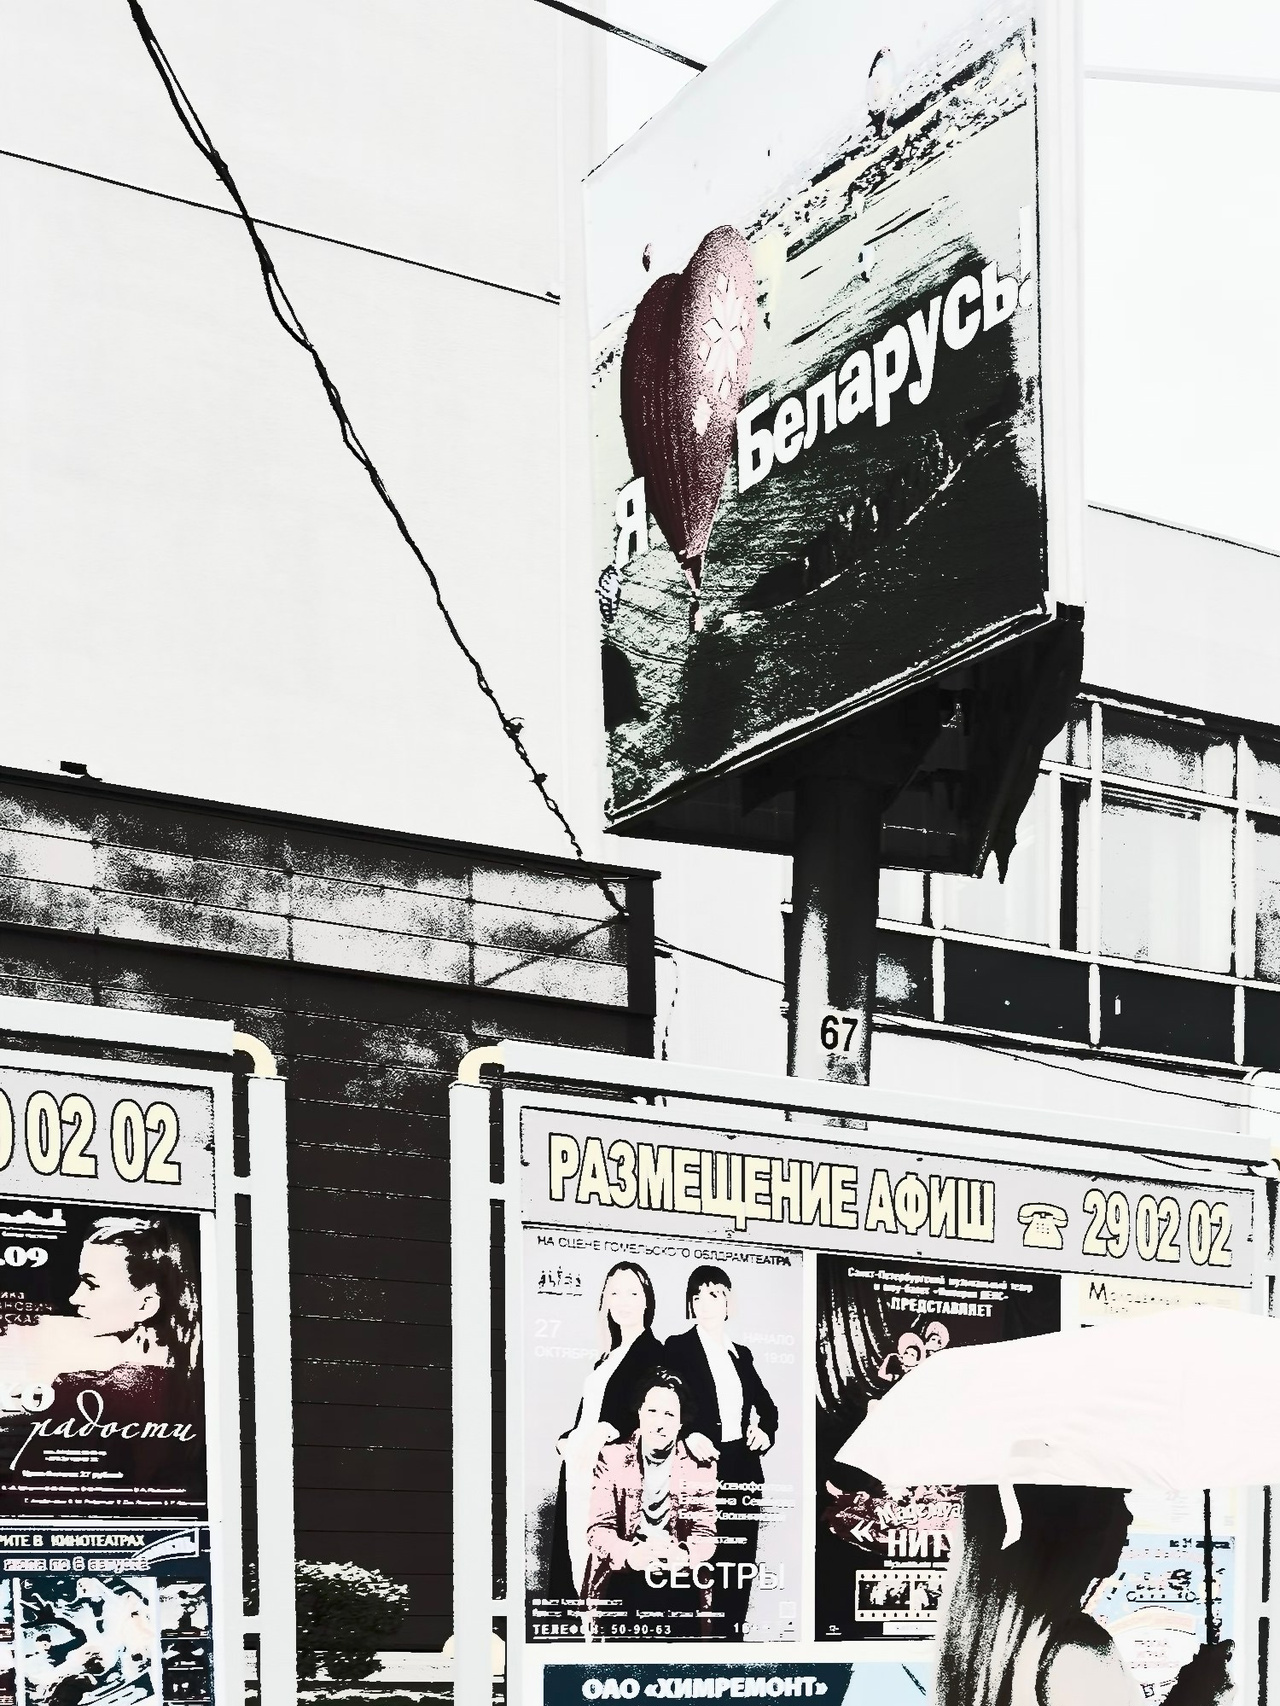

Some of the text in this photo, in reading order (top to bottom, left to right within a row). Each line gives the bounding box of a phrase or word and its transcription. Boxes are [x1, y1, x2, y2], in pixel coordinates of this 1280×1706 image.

[737, 206, 1034, 494] Беларусь!
[615, 477, 647, 565] Я
[821, 1015, 858, 1051] 67
[25, 1090, 98, 1179] 02
[110, 1098, 182, 1185] 02
[548, 1132, 1233, 1267] РАЗМЕЩЕНИЕ АФИШ 29 02 02
[537, 1235, 555, 1246] НА
[558, 1237, 601, 1251] СЦЕНЕ
[890, 1296, 993, 1317] ПРЕДСТАВЛЯЕТ
[534, 1318, 562, 1339] 27
[9, 1389, 197, 1471] радости
[33, 1534, 44, 1547] В
[51, 1534, 145, 1548] КИНОТЕАТРАХ
[644, 1561, 785, 1591] СЕСТРЫ
[611, 1623, 672, 1635] 50-90-63
[581, 1676, 829, 1700] ОАО «ХИМРЕМОНТ»
